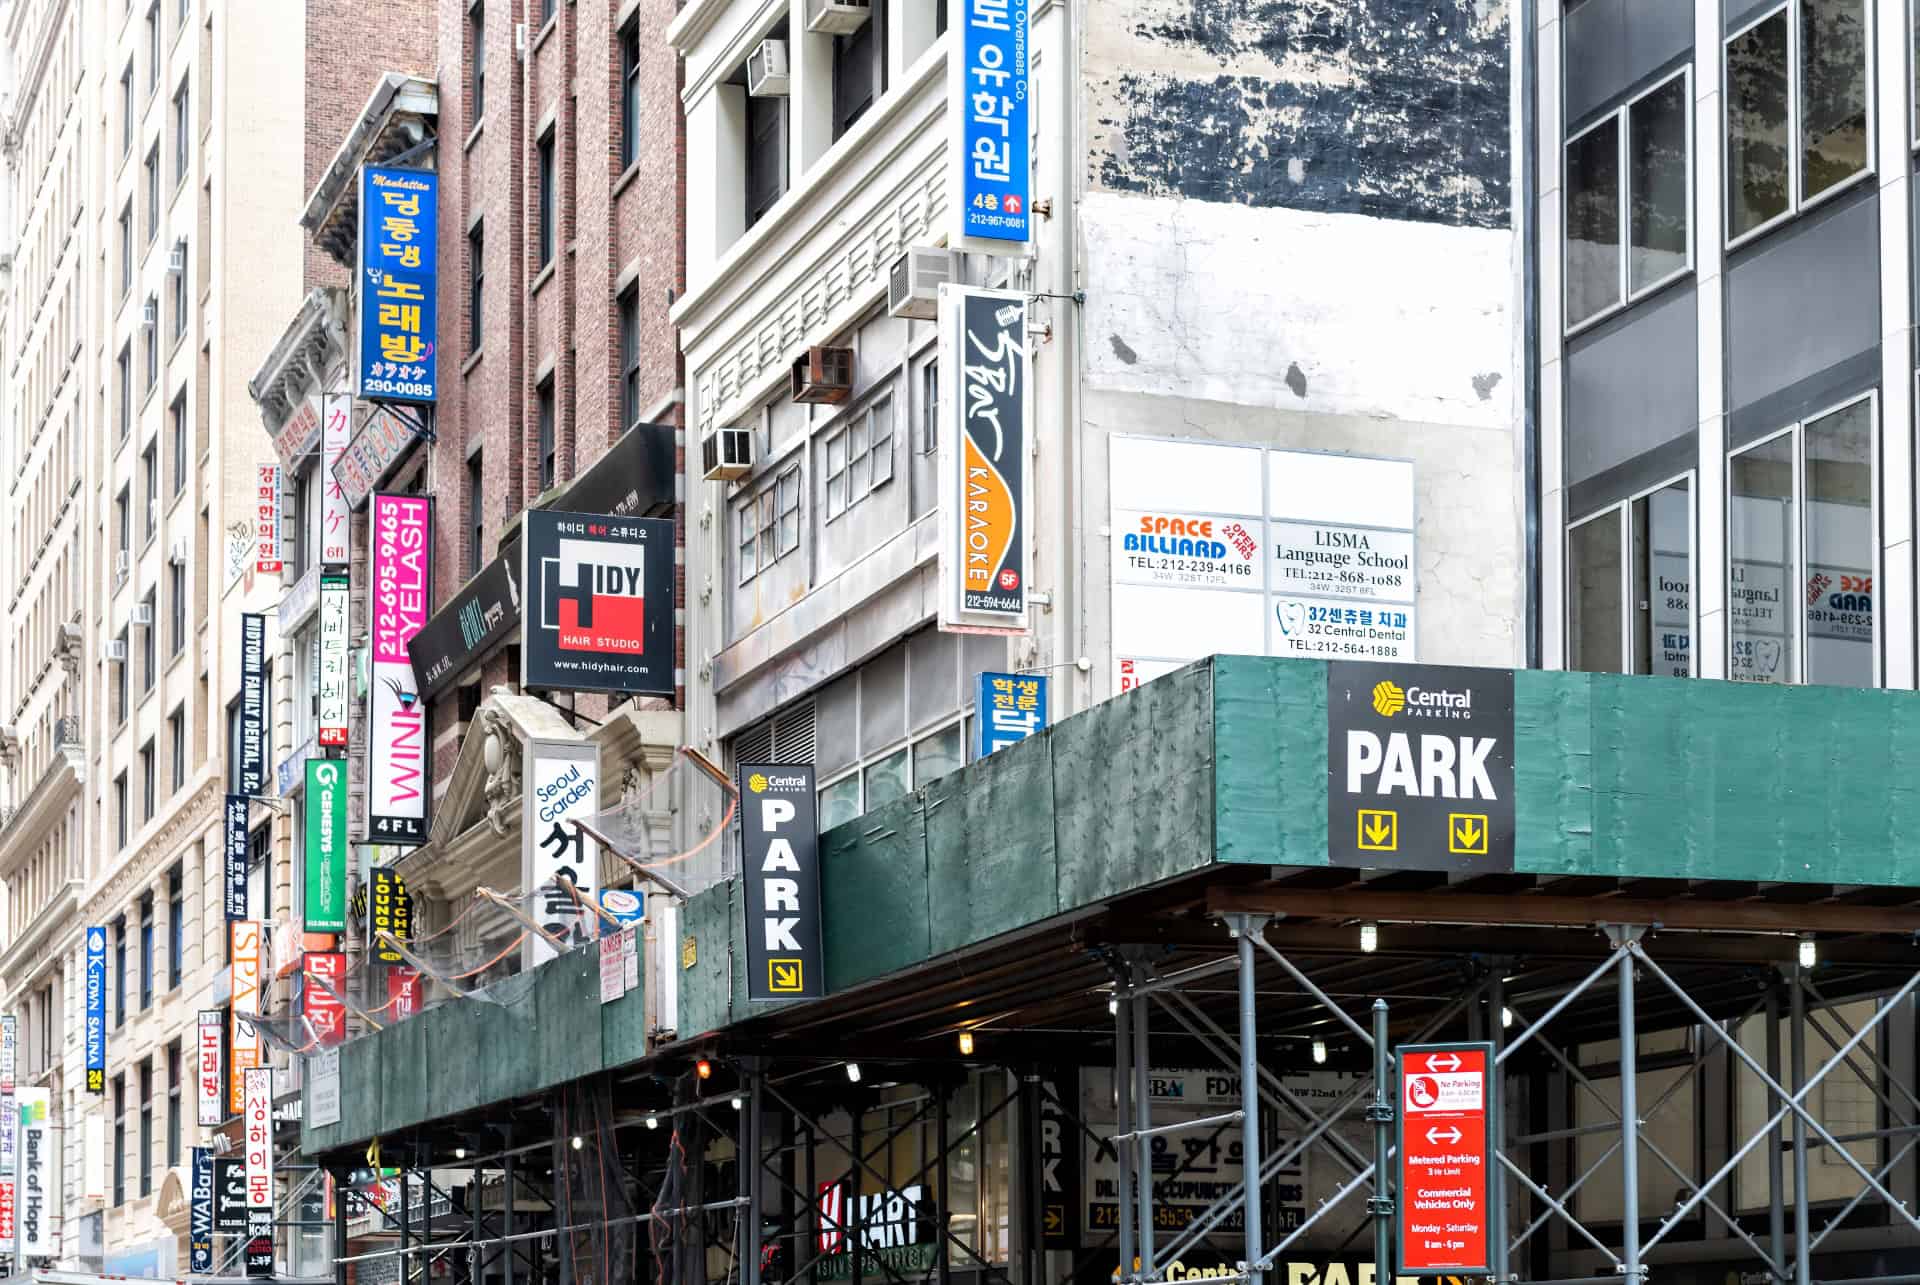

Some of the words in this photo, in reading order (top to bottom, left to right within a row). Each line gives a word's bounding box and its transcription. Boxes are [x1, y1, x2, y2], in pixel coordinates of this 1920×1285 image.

[1016, 10, 1026, 75] Overseas
[1016, 80, 1028, 103] Co.
[377, 275, 425, 362] 노래방
[365, 378, 432, 396] 290-0085
[557, 522, 585, 535] 하이디
[610, 527, 648, 539] 스튜디오
[969, 466, 988, 580] KARAOKE
[1140, 516, 1212, 538] SPACE
[1233, 523, 1257, 552] OPEN
[1123, 533, 1227, 560] BILLIARD
[1221, 525, 1235, 540] 24
[1232, 539, 1254, 561] HRS
[1315, 530, 1370, 550] LISMA
[1128, 556, 1252, 576] TEL:212-239-4166
[1276, 544, 1351, 569] Language
[1357, 551, 1409, 570] School
[379, 502, 399, 656] 212-695-9465
[1002, 573, 1017, 587] 5F
[1308, 606, 1373, 627] 32센츄럴
[1378, 611, 1407, 629] 치과
[563, 636, 591, 646] HAIR
[597, 638, 640, 649] STUDIO
[1307, 624, 1322, 635] 32
[1324, 625, 1366, 639] Central
[1369, 629, 1407, 641] Dental
[245, 617, 262, 672] MIDTOWN
[1287, 639, 1398, 658] TEL:212-564-1888
[554, 660, 649, 674] www.hidyhair.com
[244, 675, 261, 717] FAMILY
[1407, 687, 1471, 708] Central
[1407, 708, 1471, 719] PARKING
[321, 730, 345, 742] 4FL
[1347, 730, 1498, 800] PARK
[537, 764, 581, 802] Seoul
[768, 775, 806, 787] Central
[540, 778, 595, 822] Garden
[761, 799, 803, 951] PARK
[235, 931, 256, 1001] SPA
[88, 954, 104, 1011] K-TOWN
[88, 1016, 99, 1065] SAUNA
[88, 1070, 103, 1082] 24
[27, 1129, 42, 1171] Bank
[248, 1096, 268, 1204] 상하이몽
[1409, 1155, 1446, 1165] Metered
[1447, 1153, 1480, 1166] Parking
[27, 1173, 42, 1193] of
[1418, 1187, 1472, 1198] Commercial
[1414, 1200, 1451, 1210] Vehicles
[1453, 1199, 1475, 1211] Only
[24, 1196, 42, 1243] Hope
[1412, 1224, 1441, 1235] Monday
[1446, 1223, 1479, 1234] Saturday
